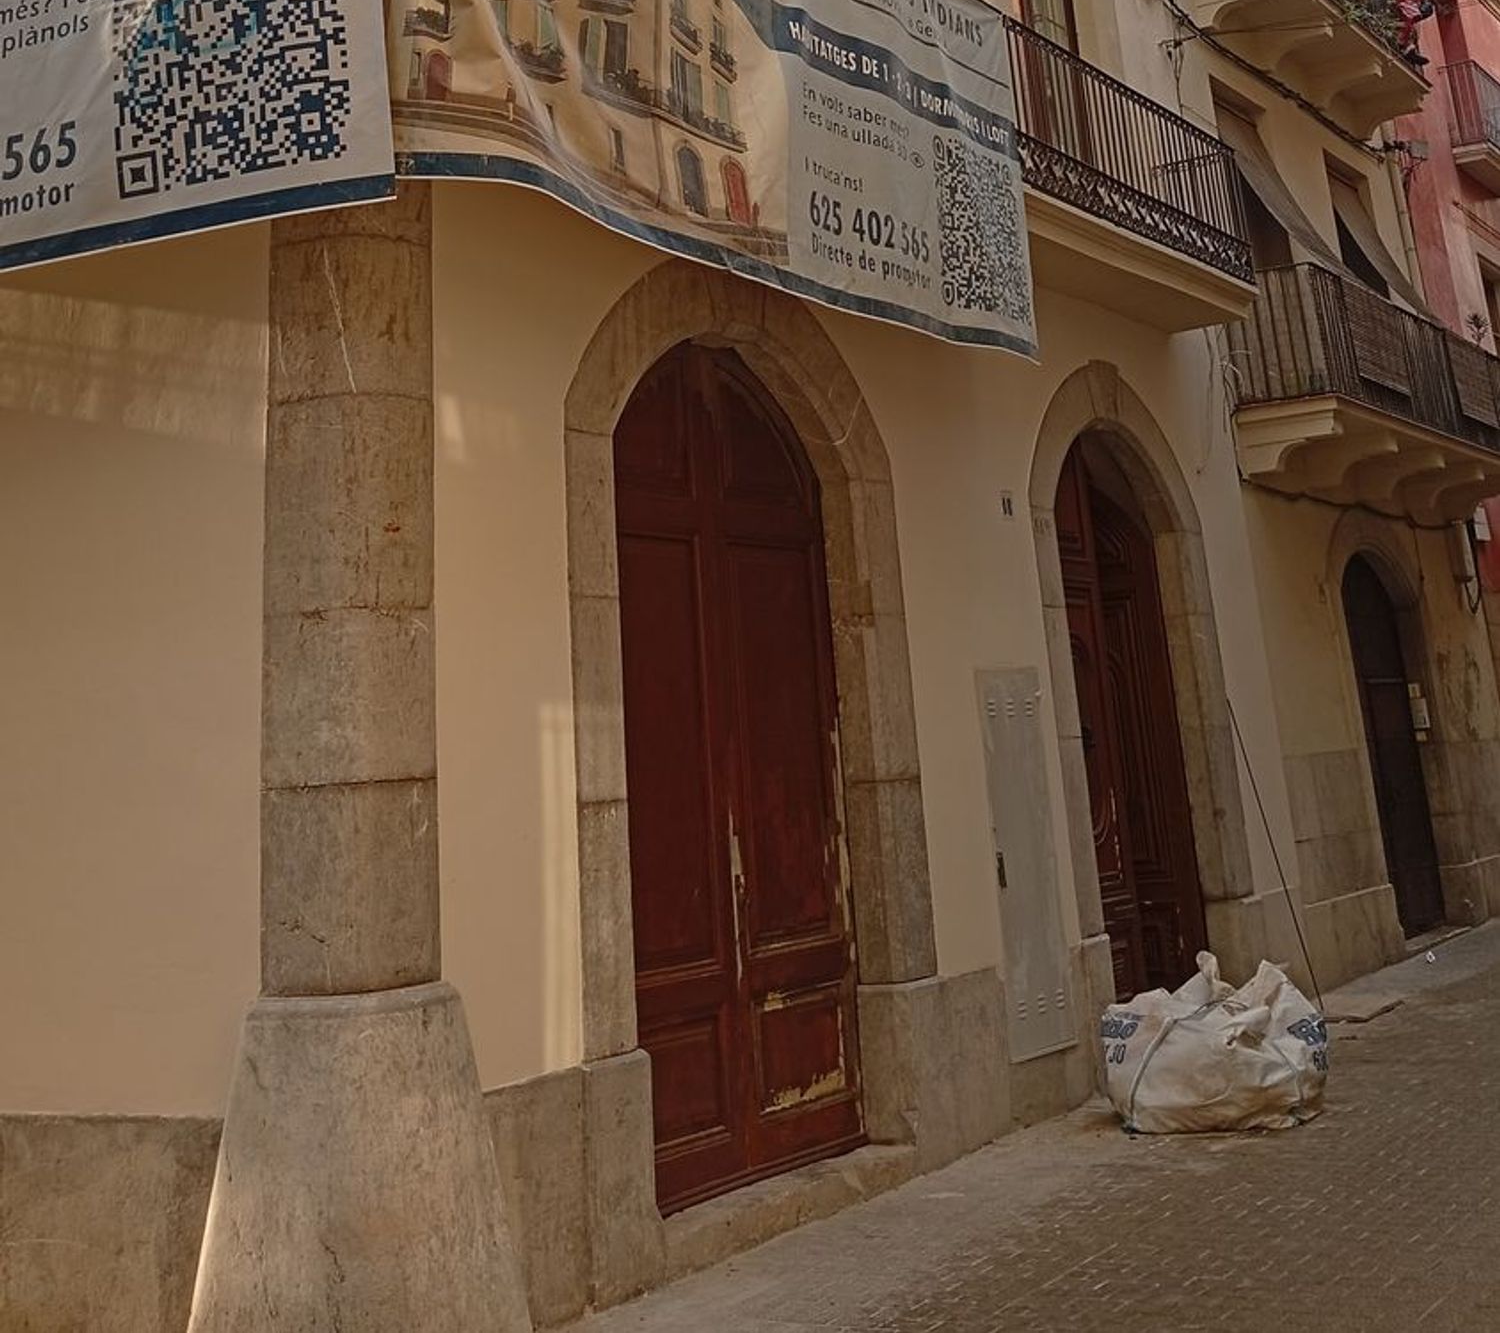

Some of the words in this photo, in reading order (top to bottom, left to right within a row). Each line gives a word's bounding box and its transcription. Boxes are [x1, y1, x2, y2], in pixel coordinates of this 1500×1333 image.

[2, 14, 89, 58] plànols
[862, 55, 880, 79] DE
[883, 63, 889, 82] 1
[803, 105, 822, 127] Fes
[825, 120, 848, 138] una
[852, 128, 895, 153] ullada
[820, 93, 844, 114] vols
[848, 106, 887, 127] saber
[2, 120, 77, 181] 565
[810, 190, 842, 236] 625
[852, 208, 895, 248] 402
[901, 221, 929, 263] 565
[812, 232, 853, 267] Directe
[859, 249, 876, 272] de
